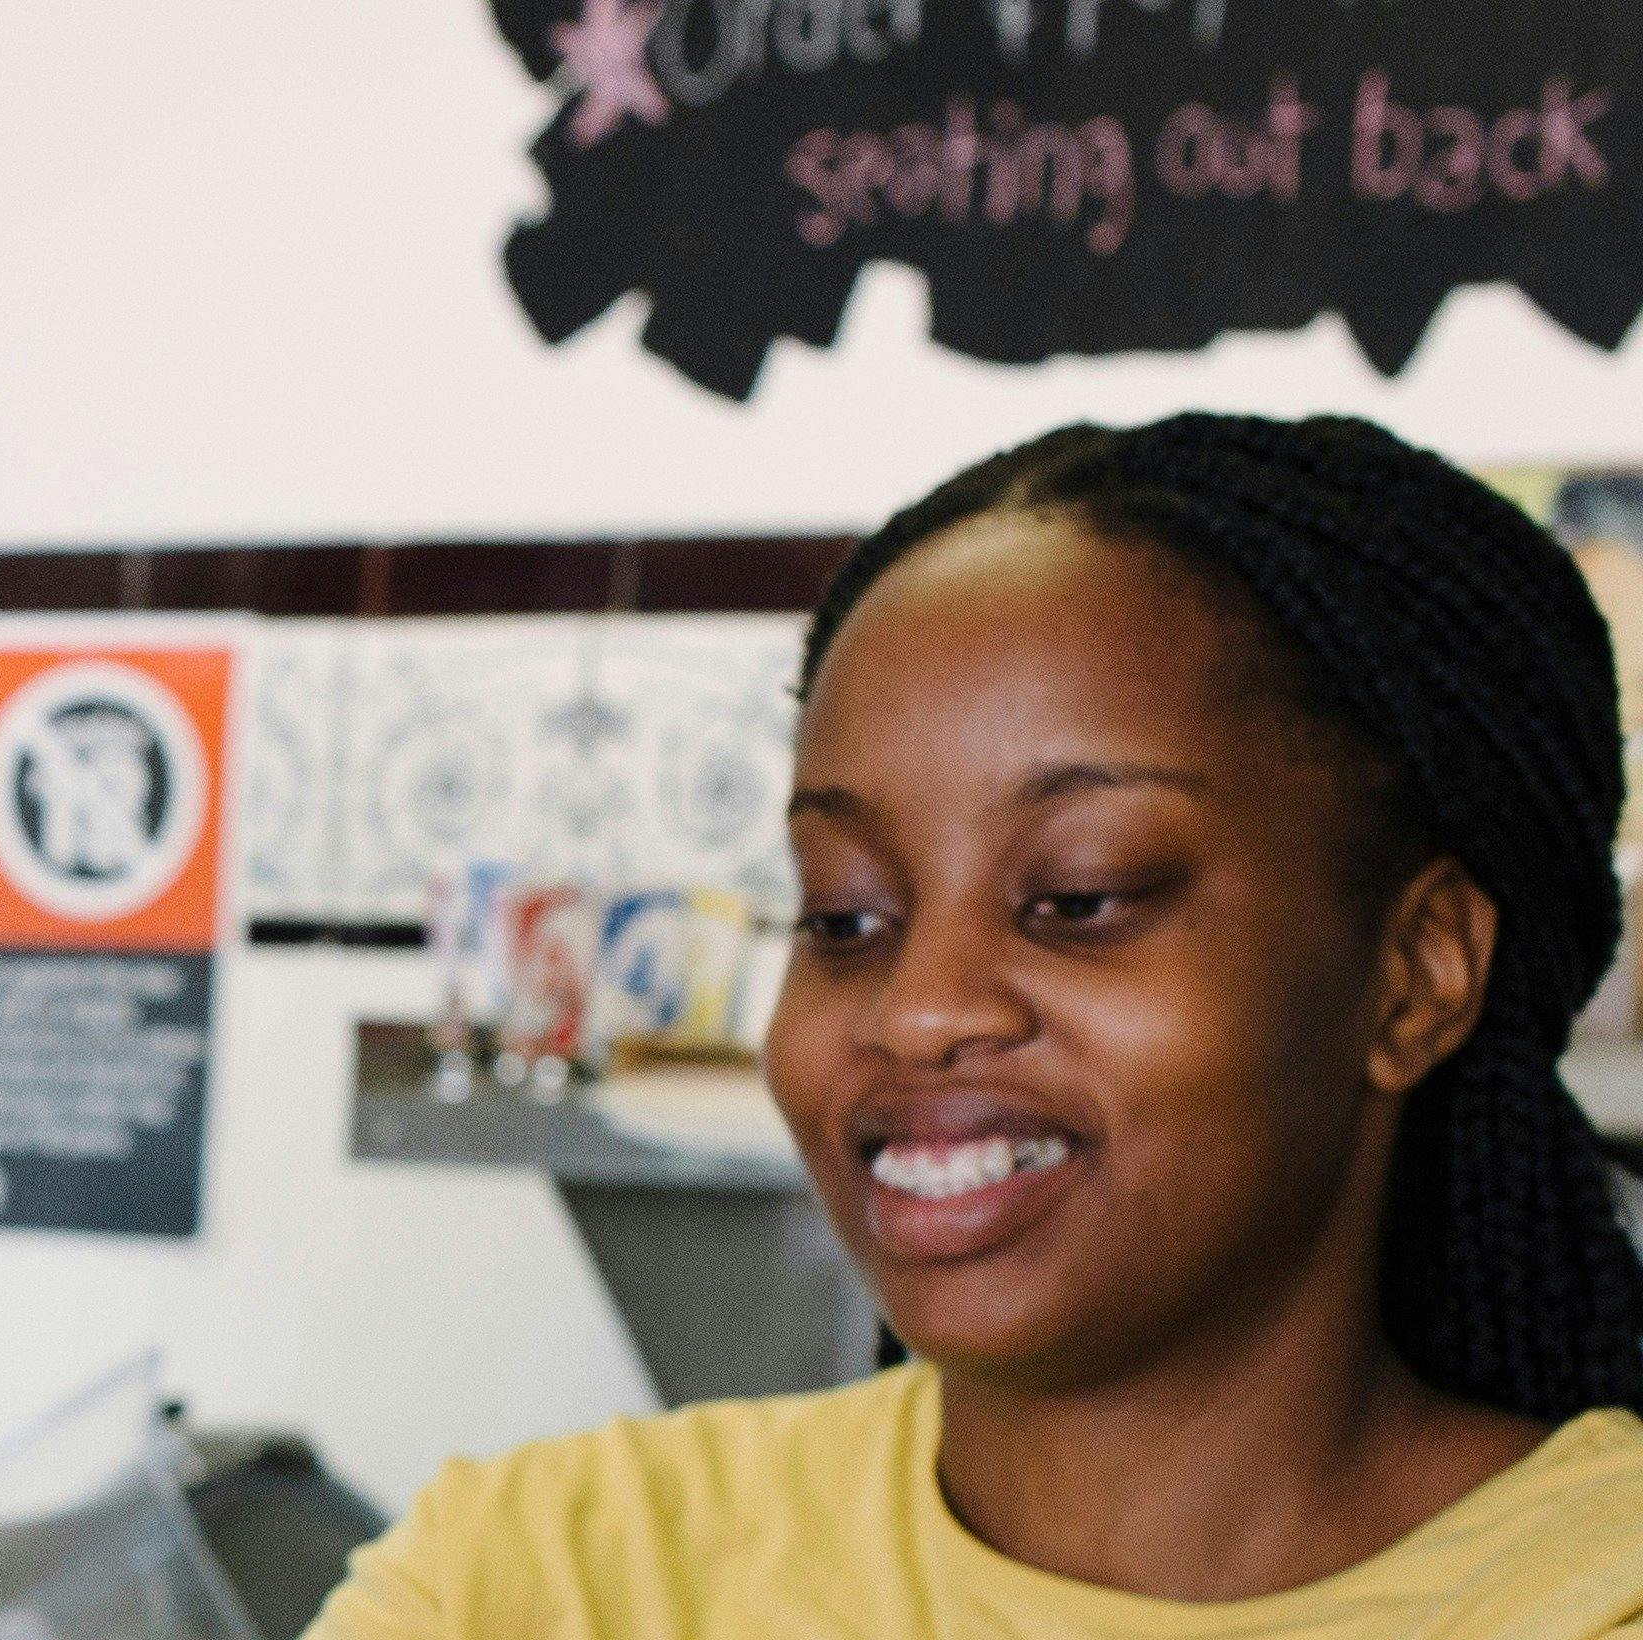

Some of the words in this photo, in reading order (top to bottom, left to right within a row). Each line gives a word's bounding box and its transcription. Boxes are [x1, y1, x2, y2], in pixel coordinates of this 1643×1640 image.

[785, 98, 1135, 252] seating
[1156, 76, 1313, 200] out
[1352, 70, 1608, 213] back
